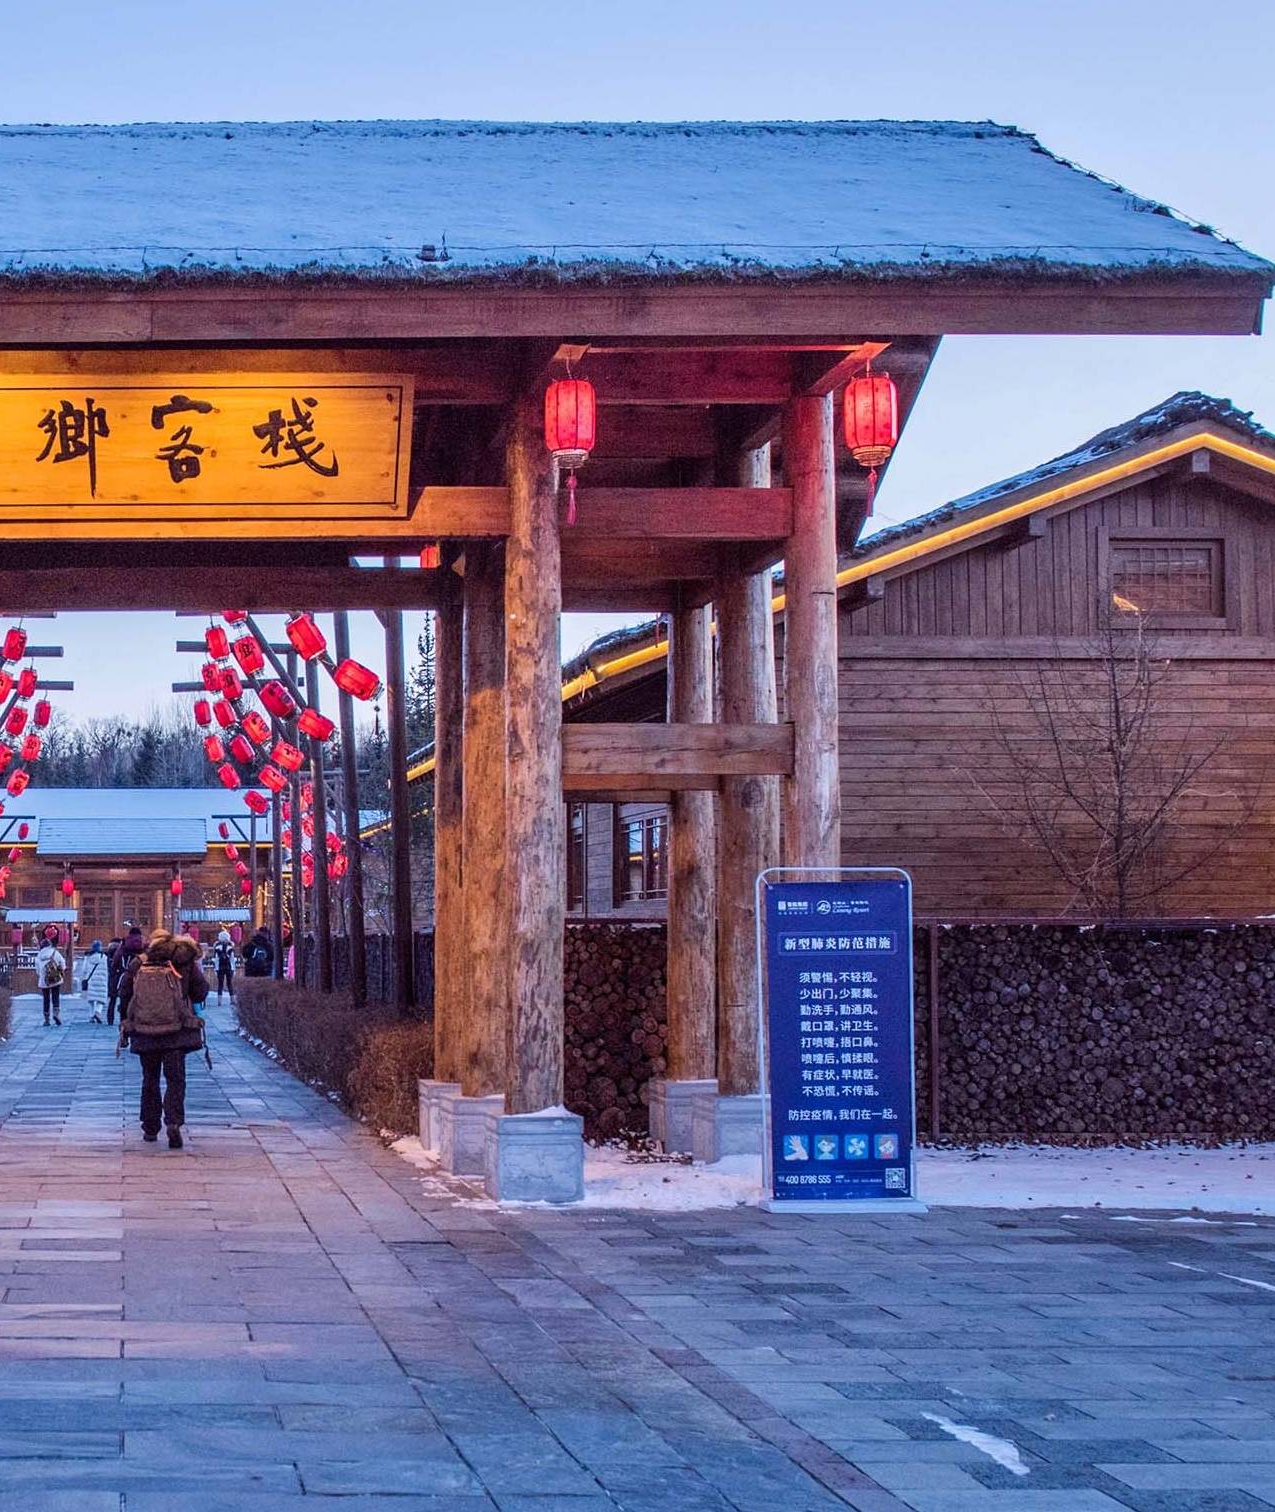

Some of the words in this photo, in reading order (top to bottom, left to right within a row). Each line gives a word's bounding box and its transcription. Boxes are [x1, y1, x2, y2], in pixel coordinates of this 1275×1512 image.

[785, 937, 891, 950] 新型肺炎防范措施
[785, 1175, 799, 1184] 400
[818, 1174, 832, 1184] 555
